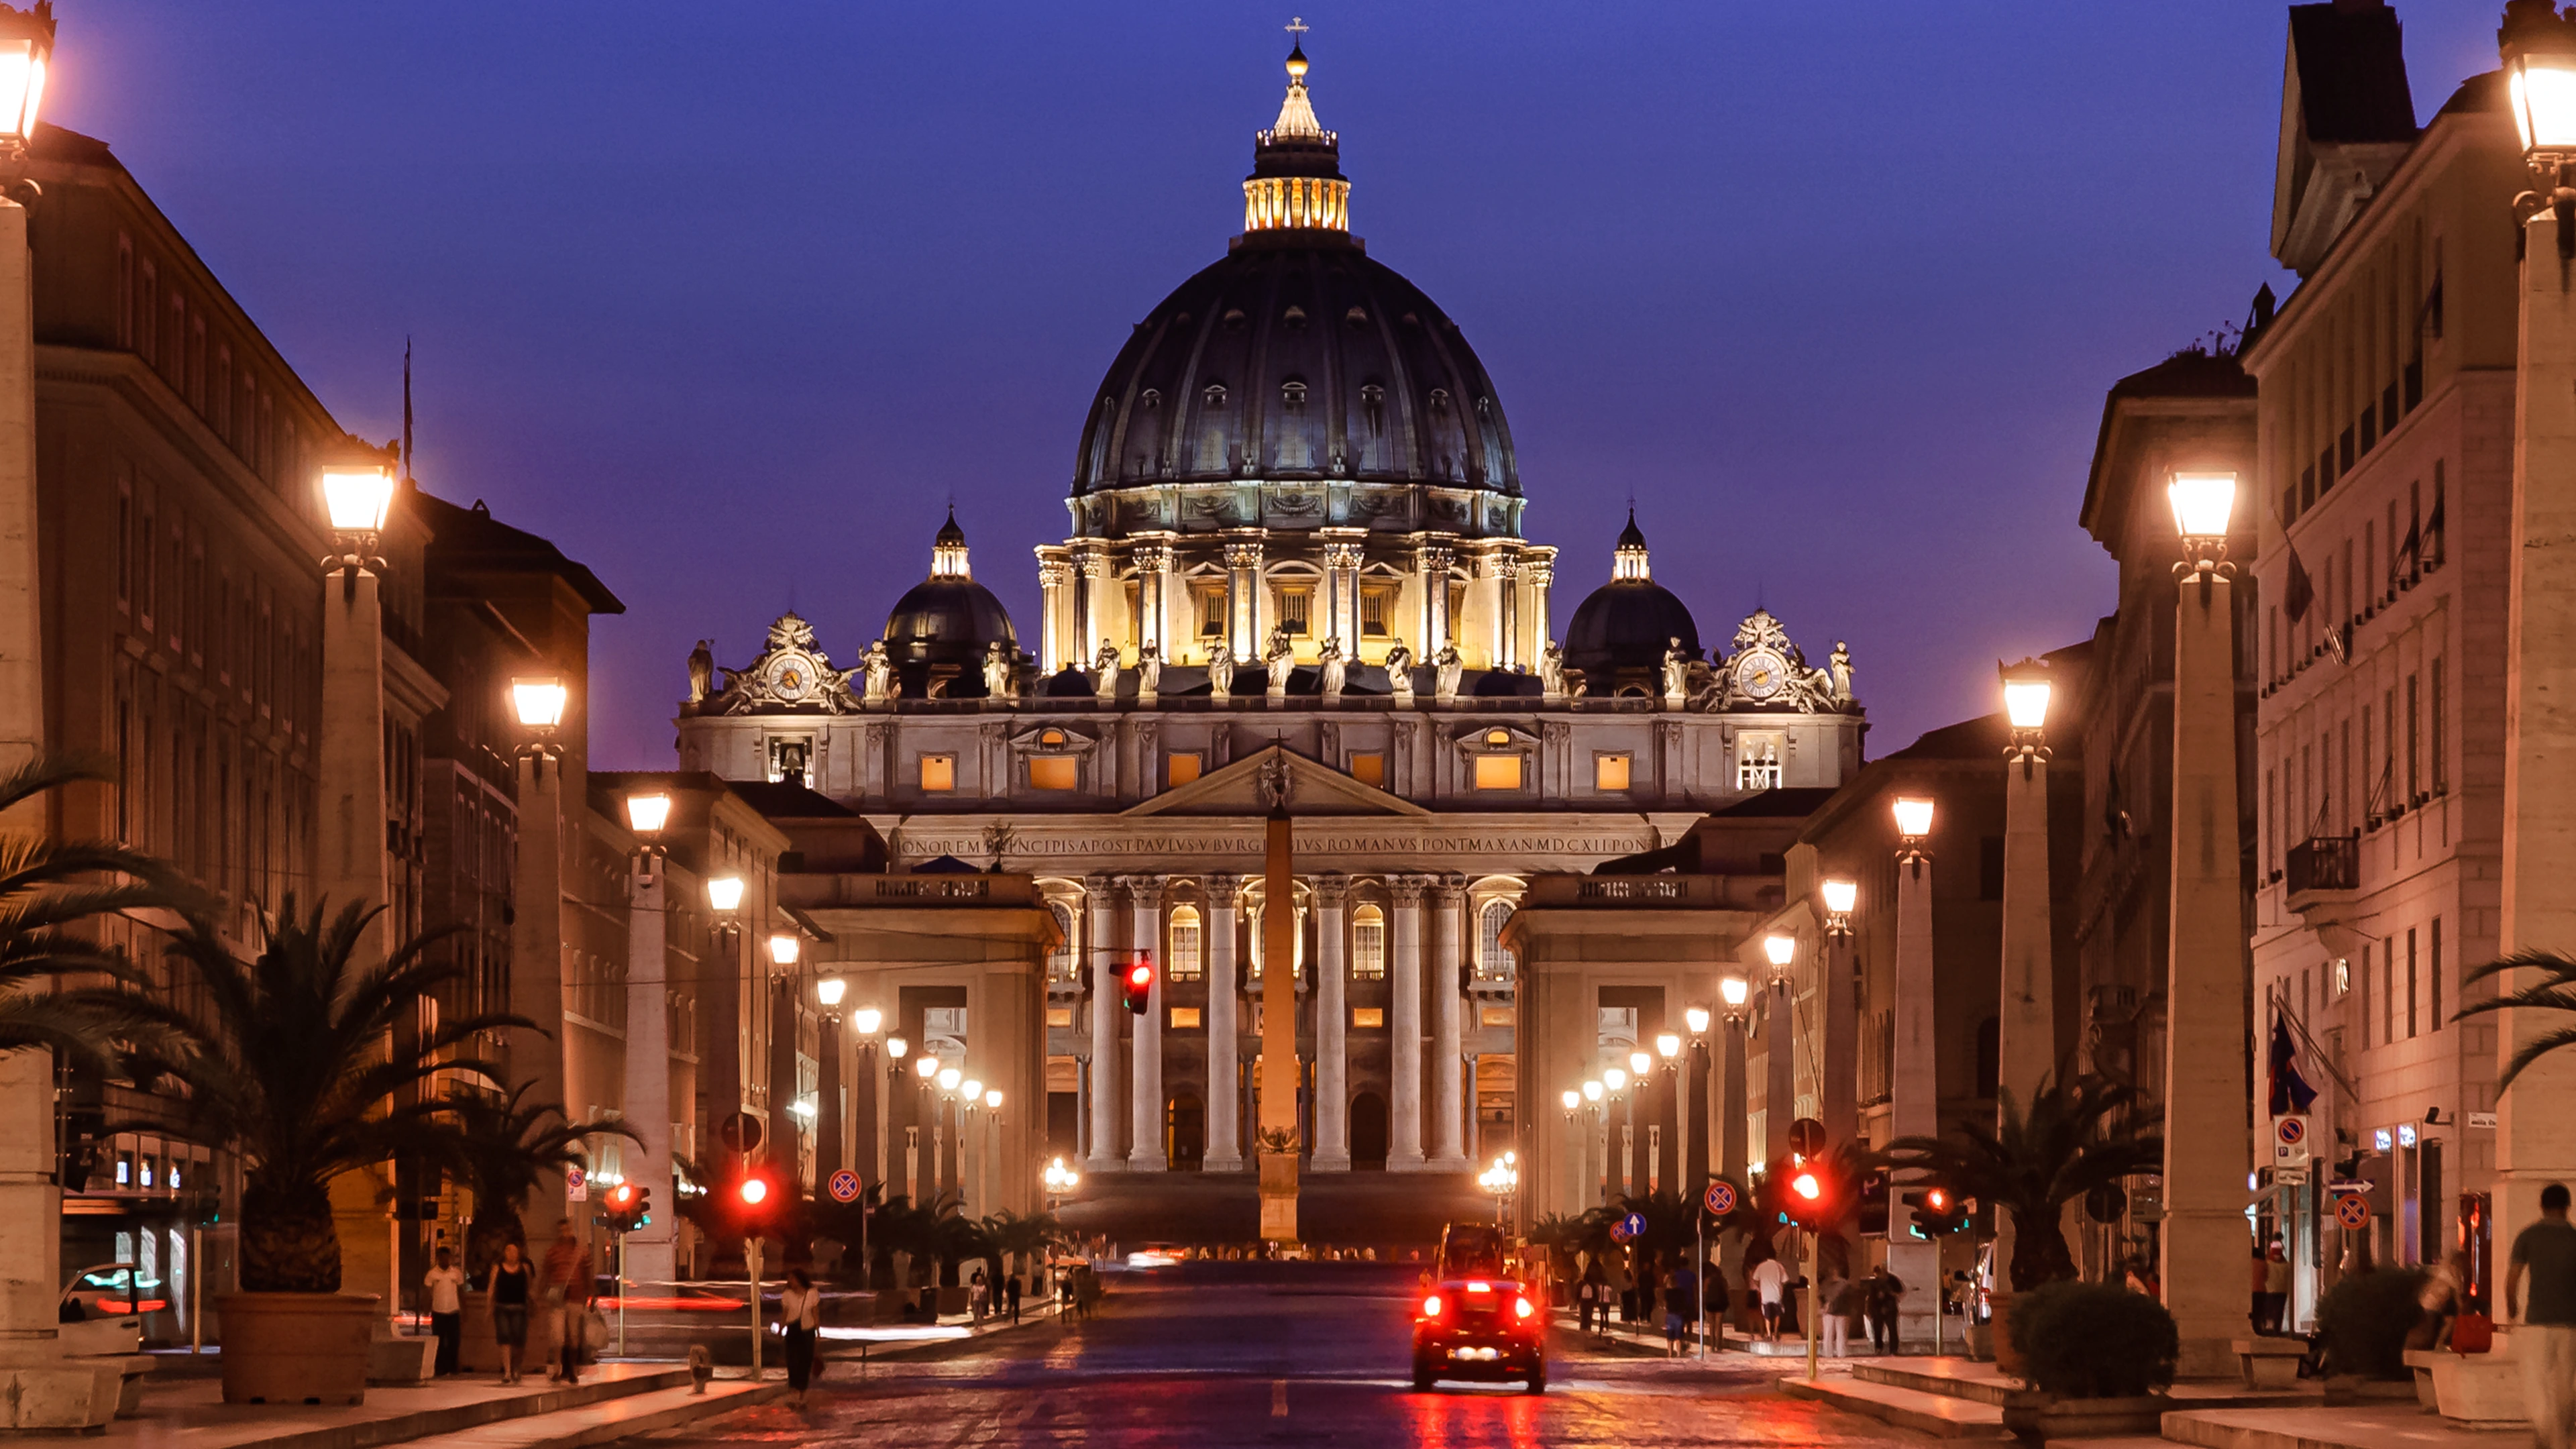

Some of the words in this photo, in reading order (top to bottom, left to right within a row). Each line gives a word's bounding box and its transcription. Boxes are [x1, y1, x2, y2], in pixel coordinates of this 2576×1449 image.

[1079, 839, 1134, 853] APOST
[1136, 839, 1194, 852] PAVLVS
[1327, 838, 1417, 852] ROMANVS
